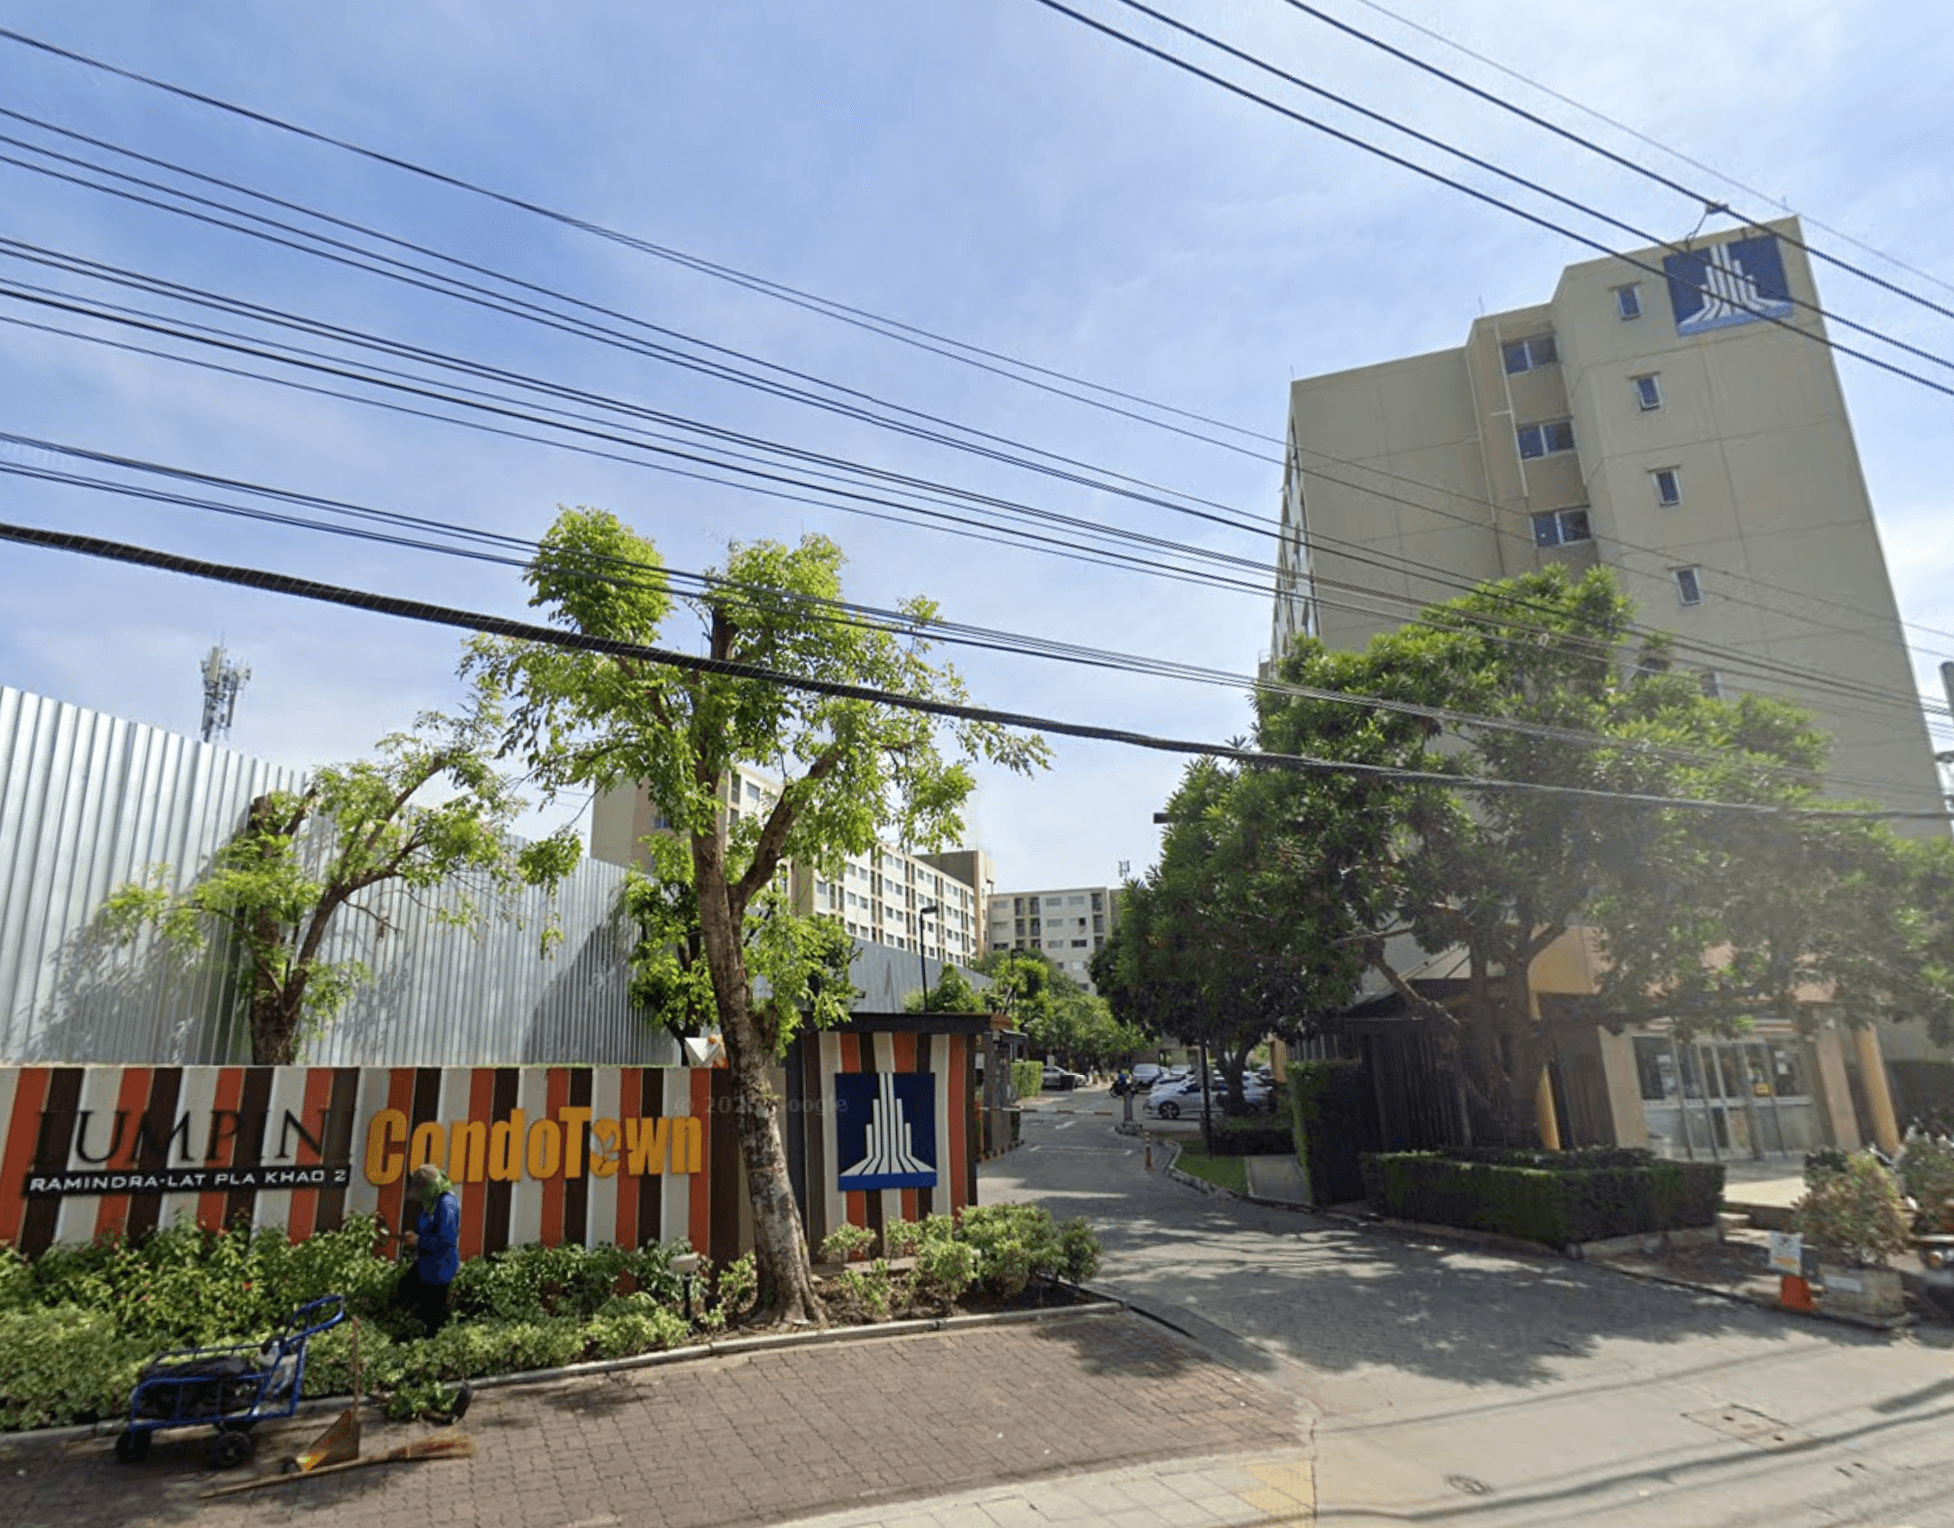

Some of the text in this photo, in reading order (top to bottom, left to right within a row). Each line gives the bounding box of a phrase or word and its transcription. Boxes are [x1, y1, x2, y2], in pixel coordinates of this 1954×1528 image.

[364, 1106, 702, 1186] CondoTown
[29, 1169, 347, 1193] RAMINDRA-LAT PLA KHAO 2
